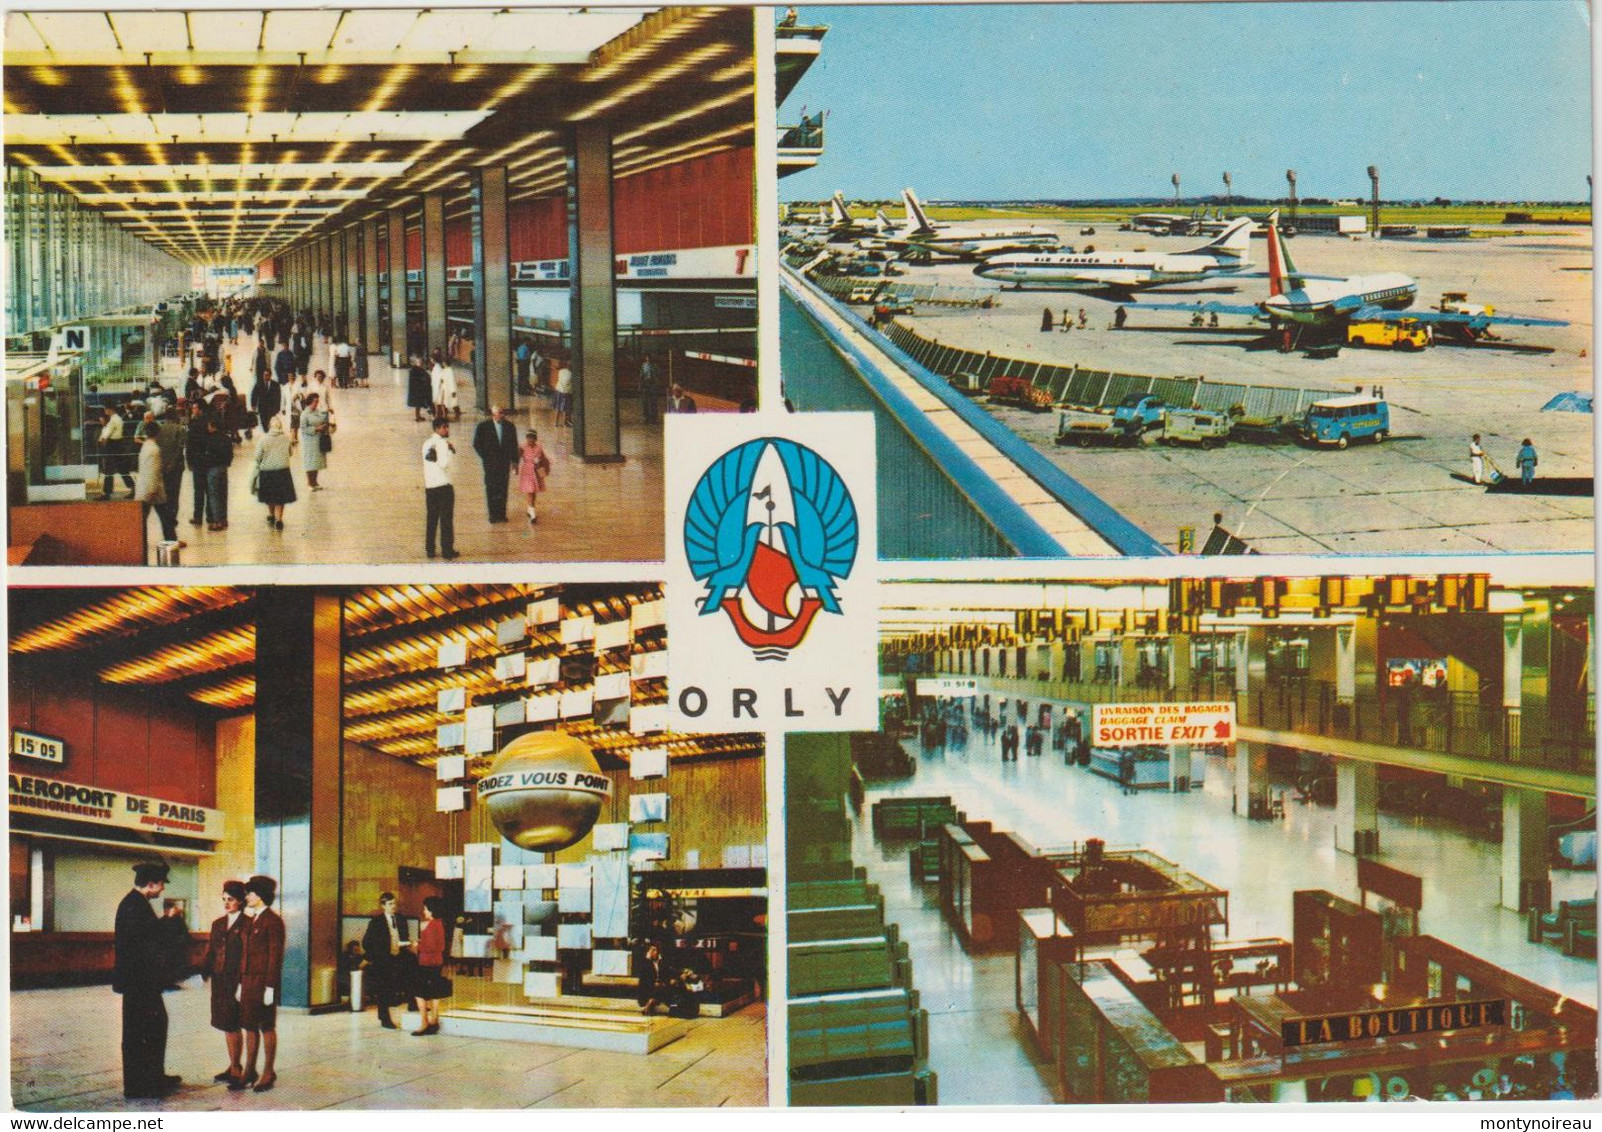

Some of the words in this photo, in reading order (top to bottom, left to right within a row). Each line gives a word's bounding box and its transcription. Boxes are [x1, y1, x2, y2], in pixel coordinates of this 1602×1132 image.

[66, 330, 84, 348] N
[678, 686, 851, 718] ORLY
[1100, 706, 1154, 715] LIVRAISON
[1159, 706, 1179, 714] DES
[1184, 705, 1230, 713] BAGAGES
[1100, 716, 1149, 725] BAGGAGE
[1154, 716, 1187, 724] CLAIM
[1100, 727, 1164, 741] SORTIE
[1171, 725, 1208, 739] EXIT
[21, 738, 34, 754] 15
[40, 746, 56, 759] 05
[521, 772, 568, 785] VOUS
[574, 773, 608, 791] POINT
[9, 774, 117, 808] AEROPORT
[126, 796, 149, 815] DE
[159, 803, 206, 823] PARIS
[9, 794, 112, 819] ENSEIGNEMENTS
[140, 816, 206, 832] INFORMATION
[1300, 1019, 1332, 1044] LA
[1351, 1003, 1492, 1039] BOUTIQUE
